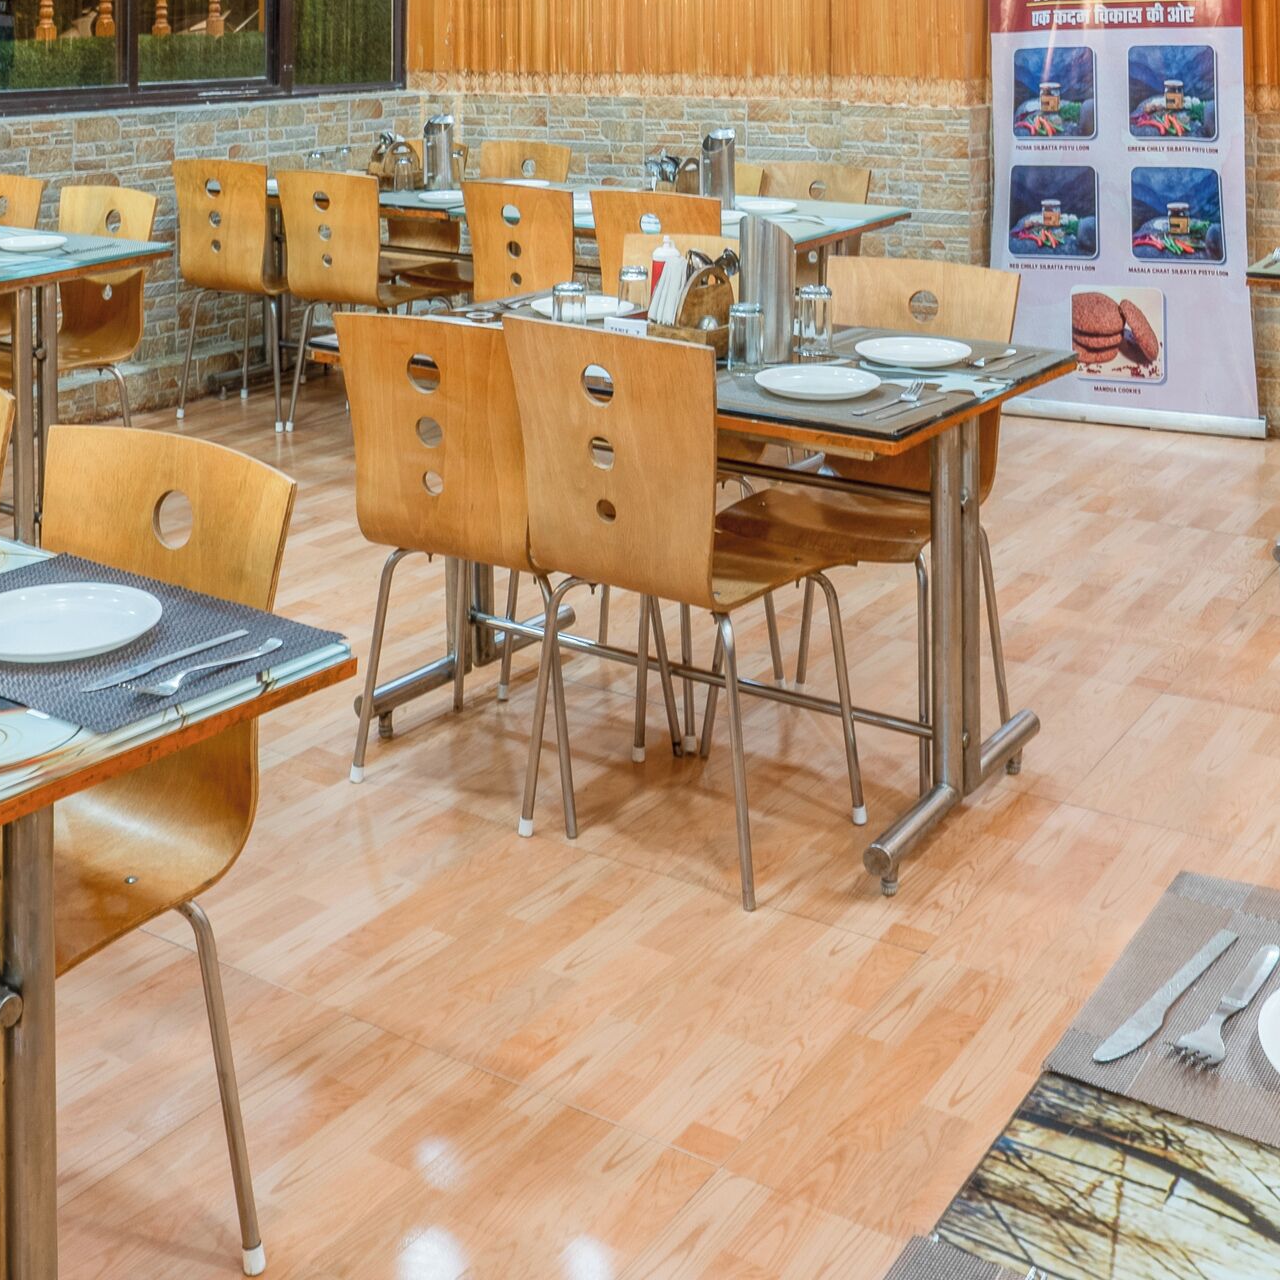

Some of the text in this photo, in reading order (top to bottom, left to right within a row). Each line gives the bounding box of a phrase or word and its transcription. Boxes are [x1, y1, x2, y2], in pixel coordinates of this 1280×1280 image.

[1031, 2, 1196, 27] एक कदम विकास की ओर
